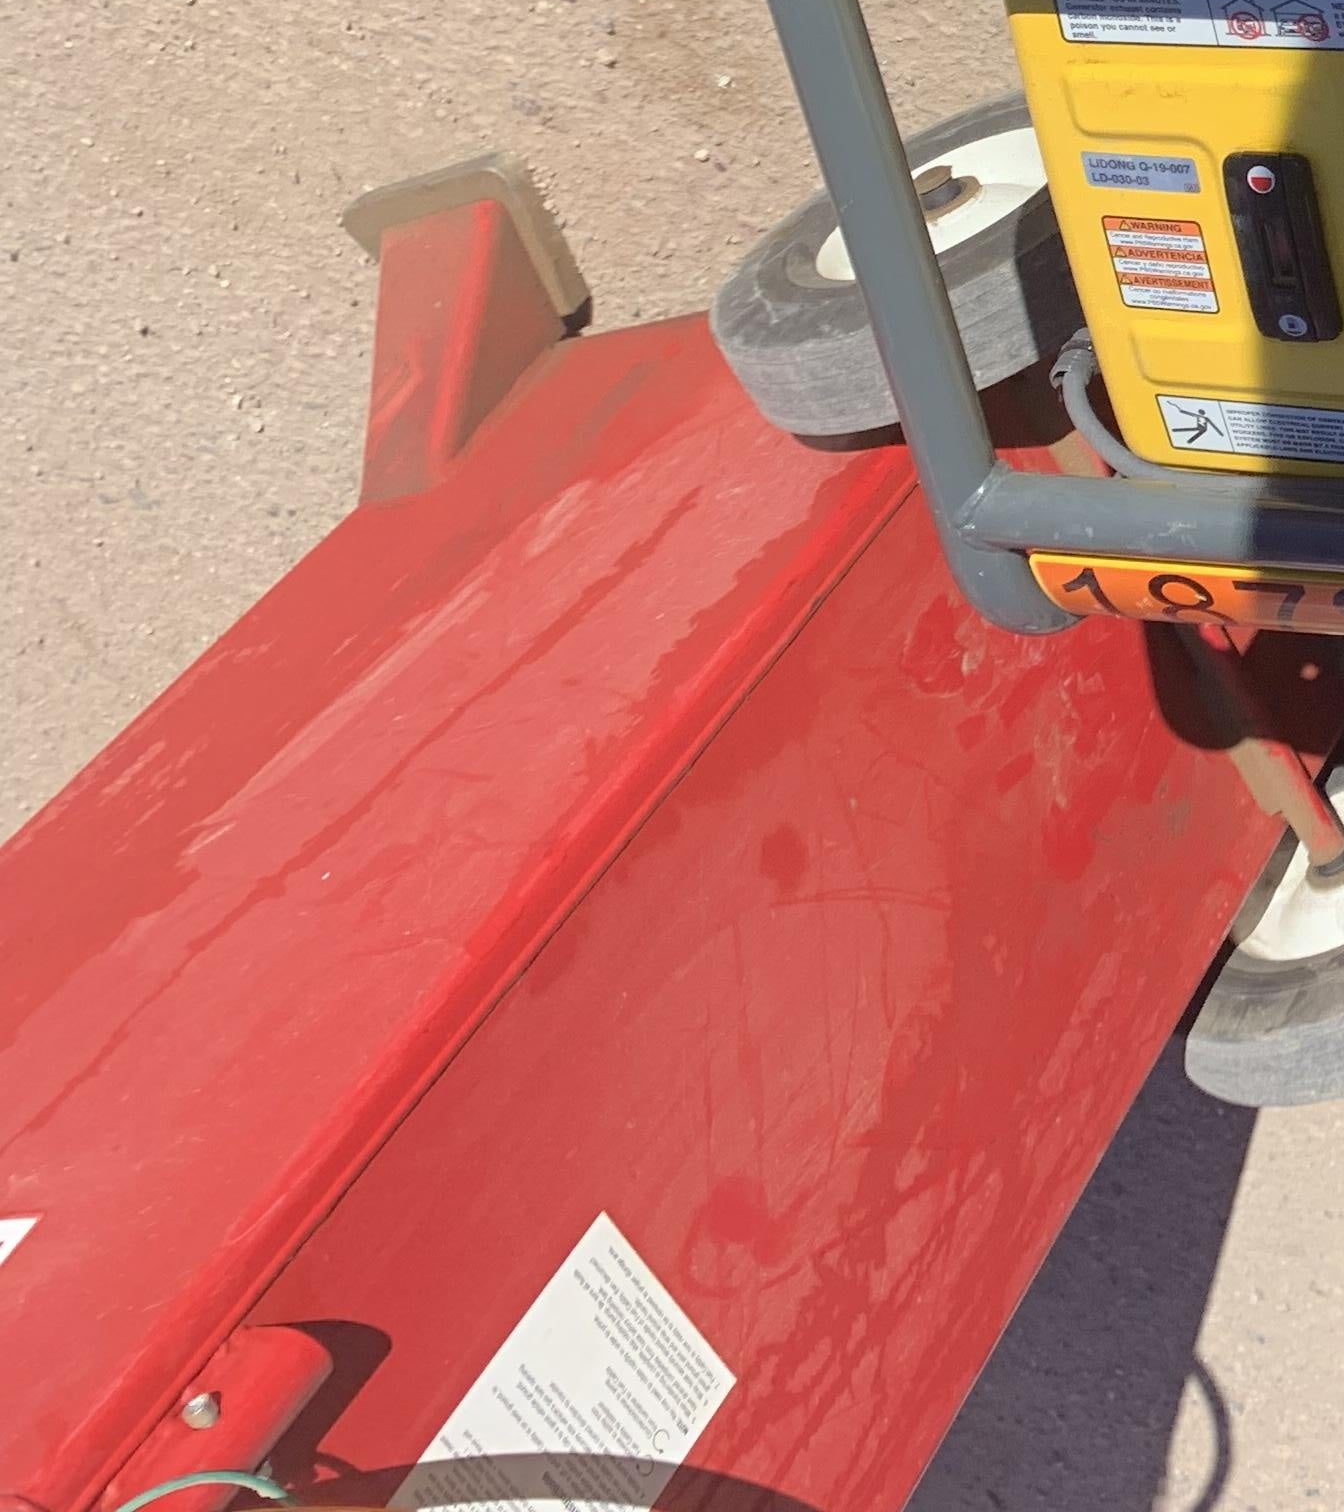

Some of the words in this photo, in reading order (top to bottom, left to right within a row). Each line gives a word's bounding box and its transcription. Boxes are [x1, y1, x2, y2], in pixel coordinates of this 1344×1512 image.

[1089, 158, 1136, 171] LIDONG
[1139, 161, 1191, 174] Q-19-007
[1092, 173, 1149, 186] LD-030-03
[1130, 221, 1182, 233] WARNING
[1128, 248, 1205, 262] ADVERTENCIA
[1134, 276, 1210, 289] AVERTISSEMENT
